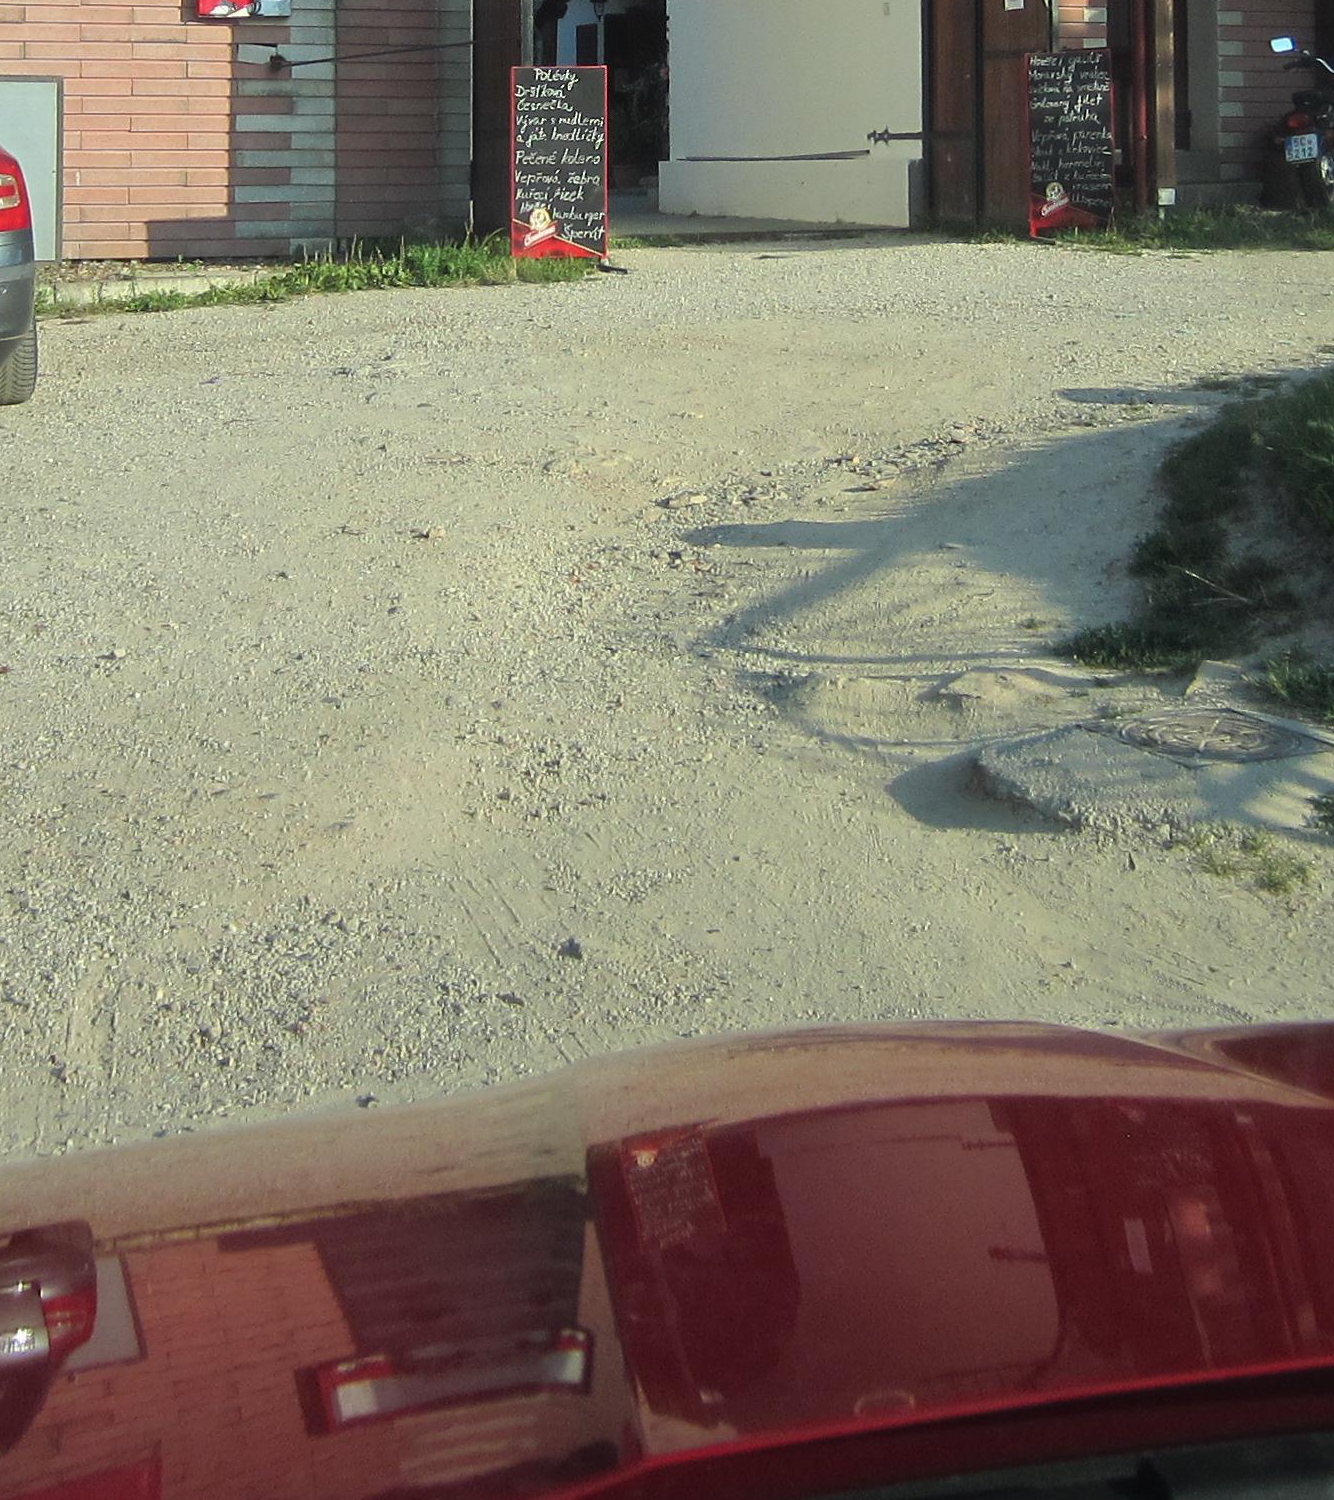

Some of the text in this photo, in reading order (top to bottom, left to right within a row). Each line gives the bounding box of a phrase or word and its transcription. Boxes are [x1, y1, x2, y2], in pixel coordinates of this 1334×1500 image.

[534, 67, 580, 90] Polévky
[515, 113, 604, 133] Vývar s nudlemi
[515, 147, 601, 165] Pečené koleno
